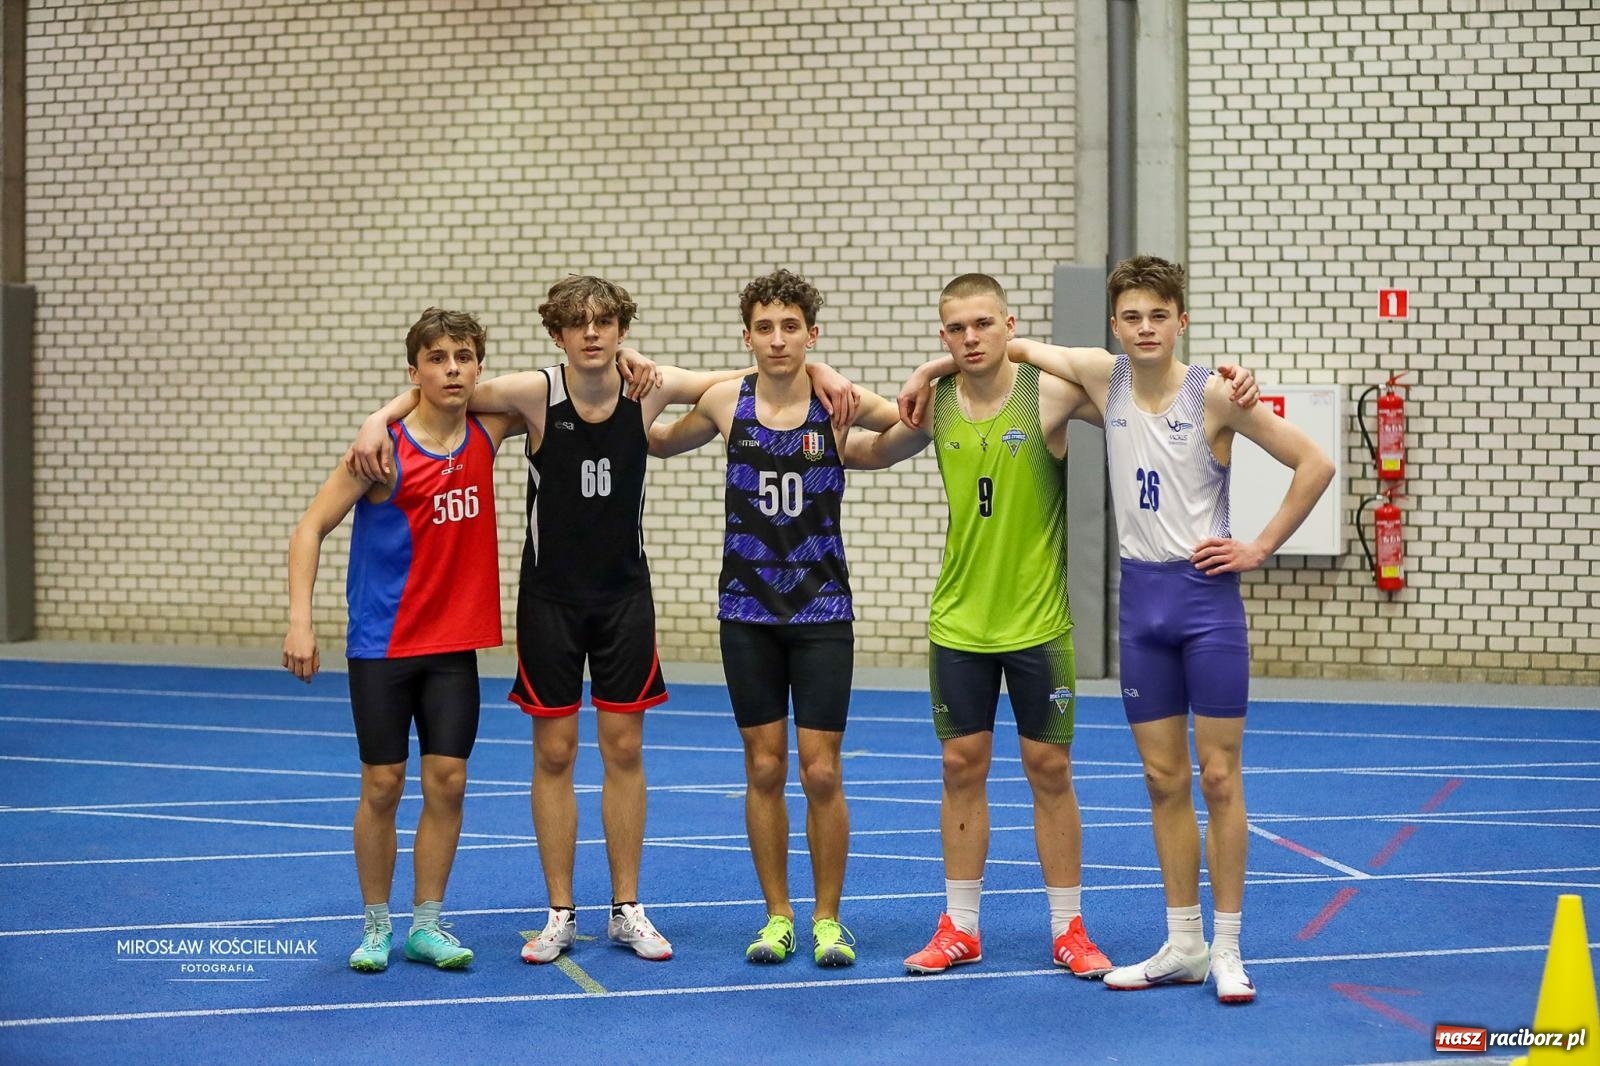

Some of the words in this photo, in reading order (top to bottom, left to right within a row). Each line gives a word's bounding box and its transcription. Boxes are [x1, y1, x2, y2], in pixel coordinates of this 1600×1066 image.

[581, 457, 612, 498] 66
[759, 470, 803, 517] 50
[977, 476, 994, 518] 9
[1136, 467, 1160, 512] 26
[432, 485, 480, 525] 566
